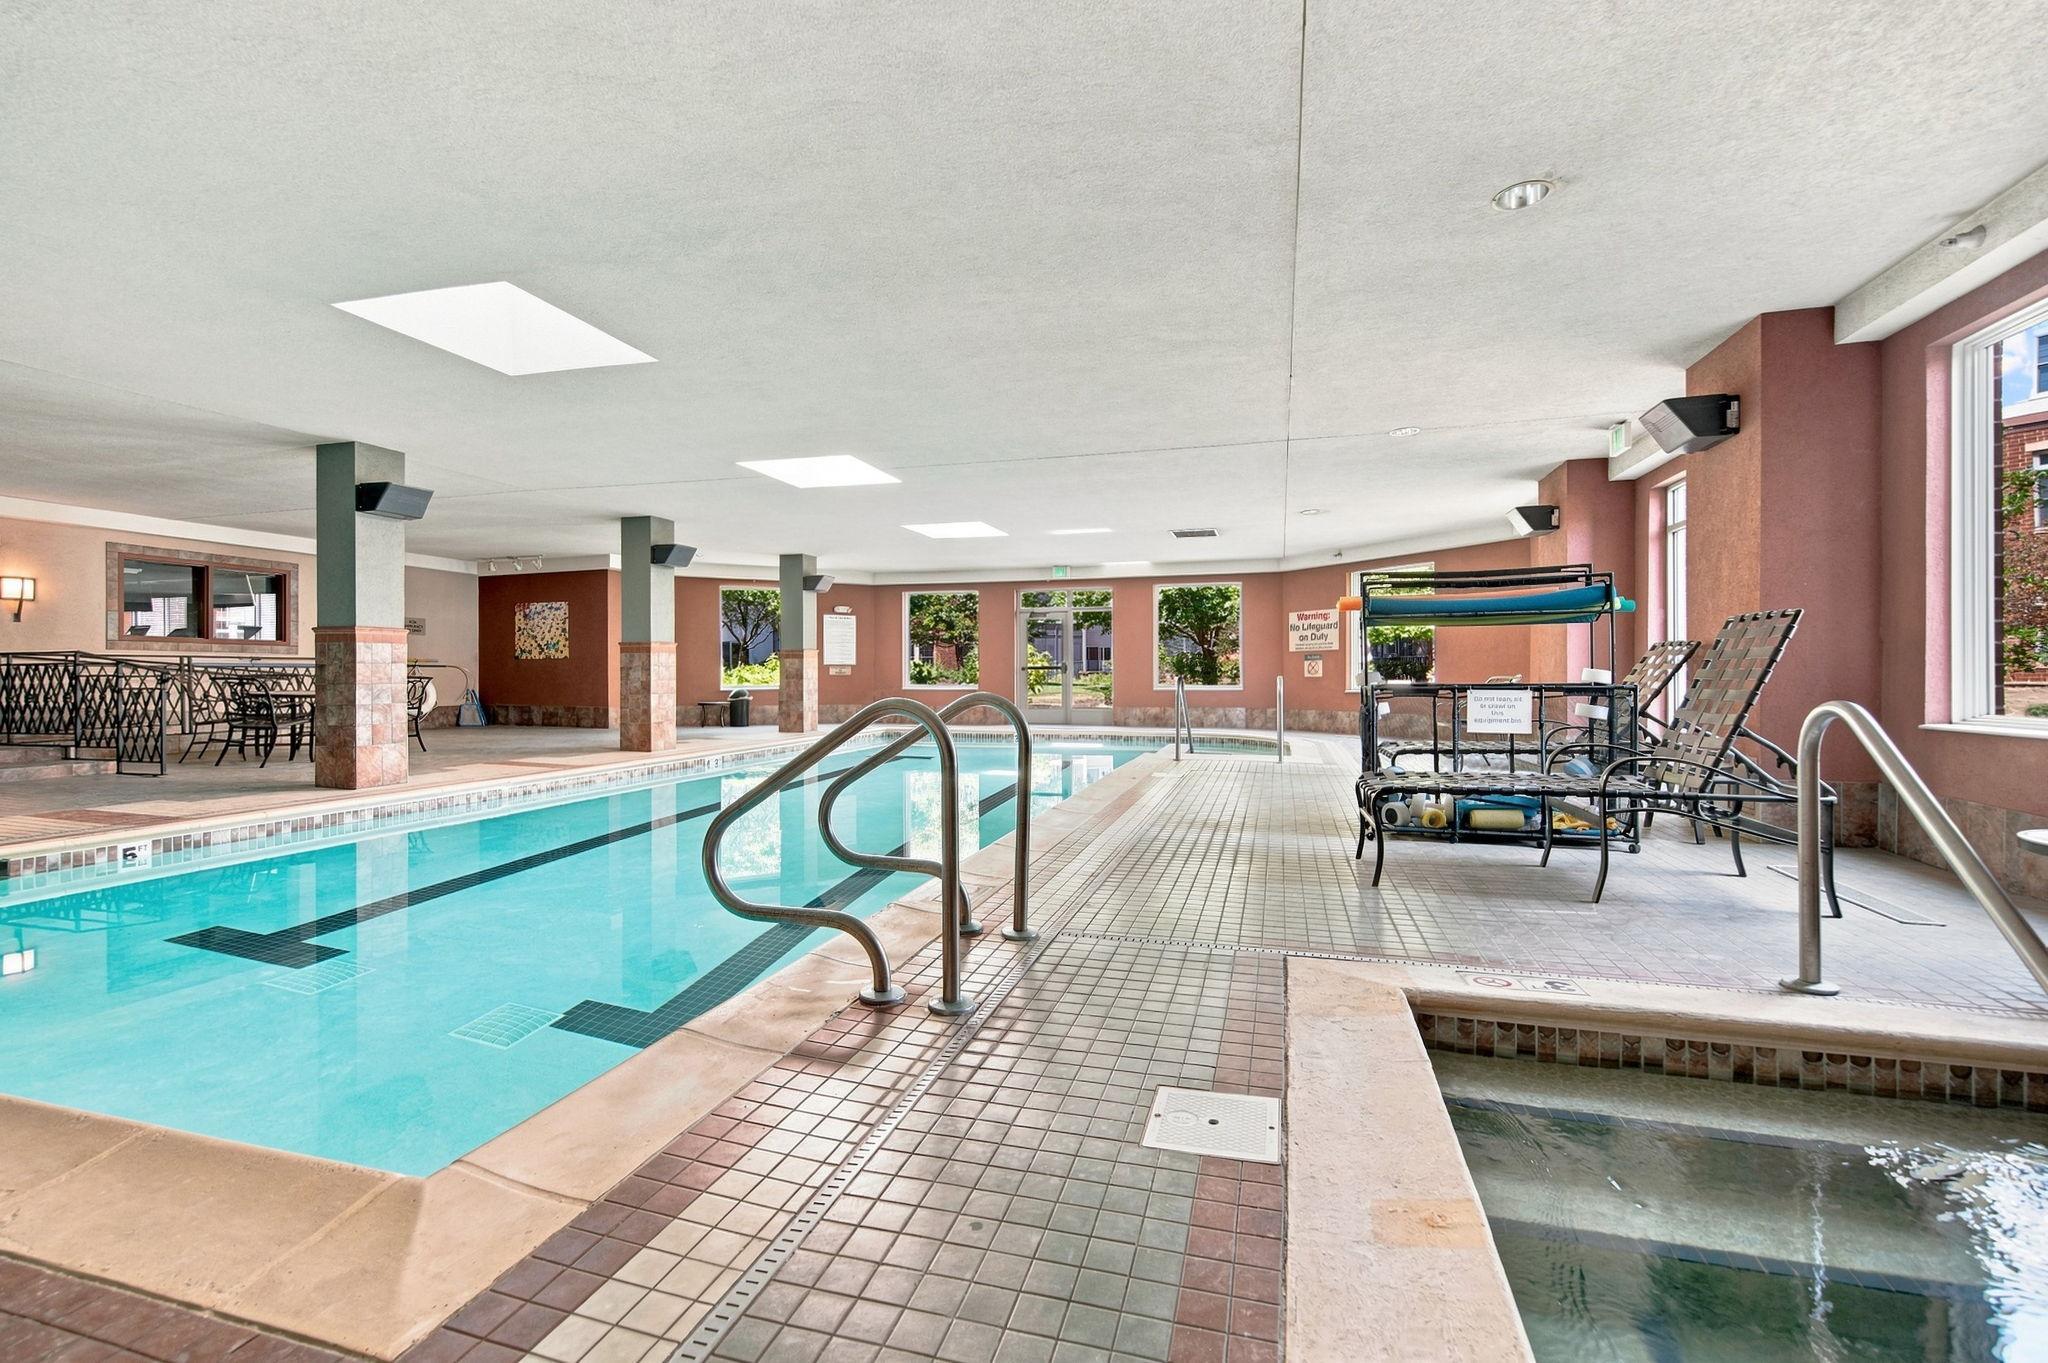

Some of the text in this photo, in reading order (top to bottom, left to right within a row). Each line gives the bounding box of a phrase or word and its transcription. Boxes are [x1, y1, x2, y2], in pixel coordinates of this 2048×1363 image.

[1297, 612, 1330, 621] Warning:
[1290, 621, 1338, 632] No Lifeguard
[1311, 633, 1328, 641] Duty
